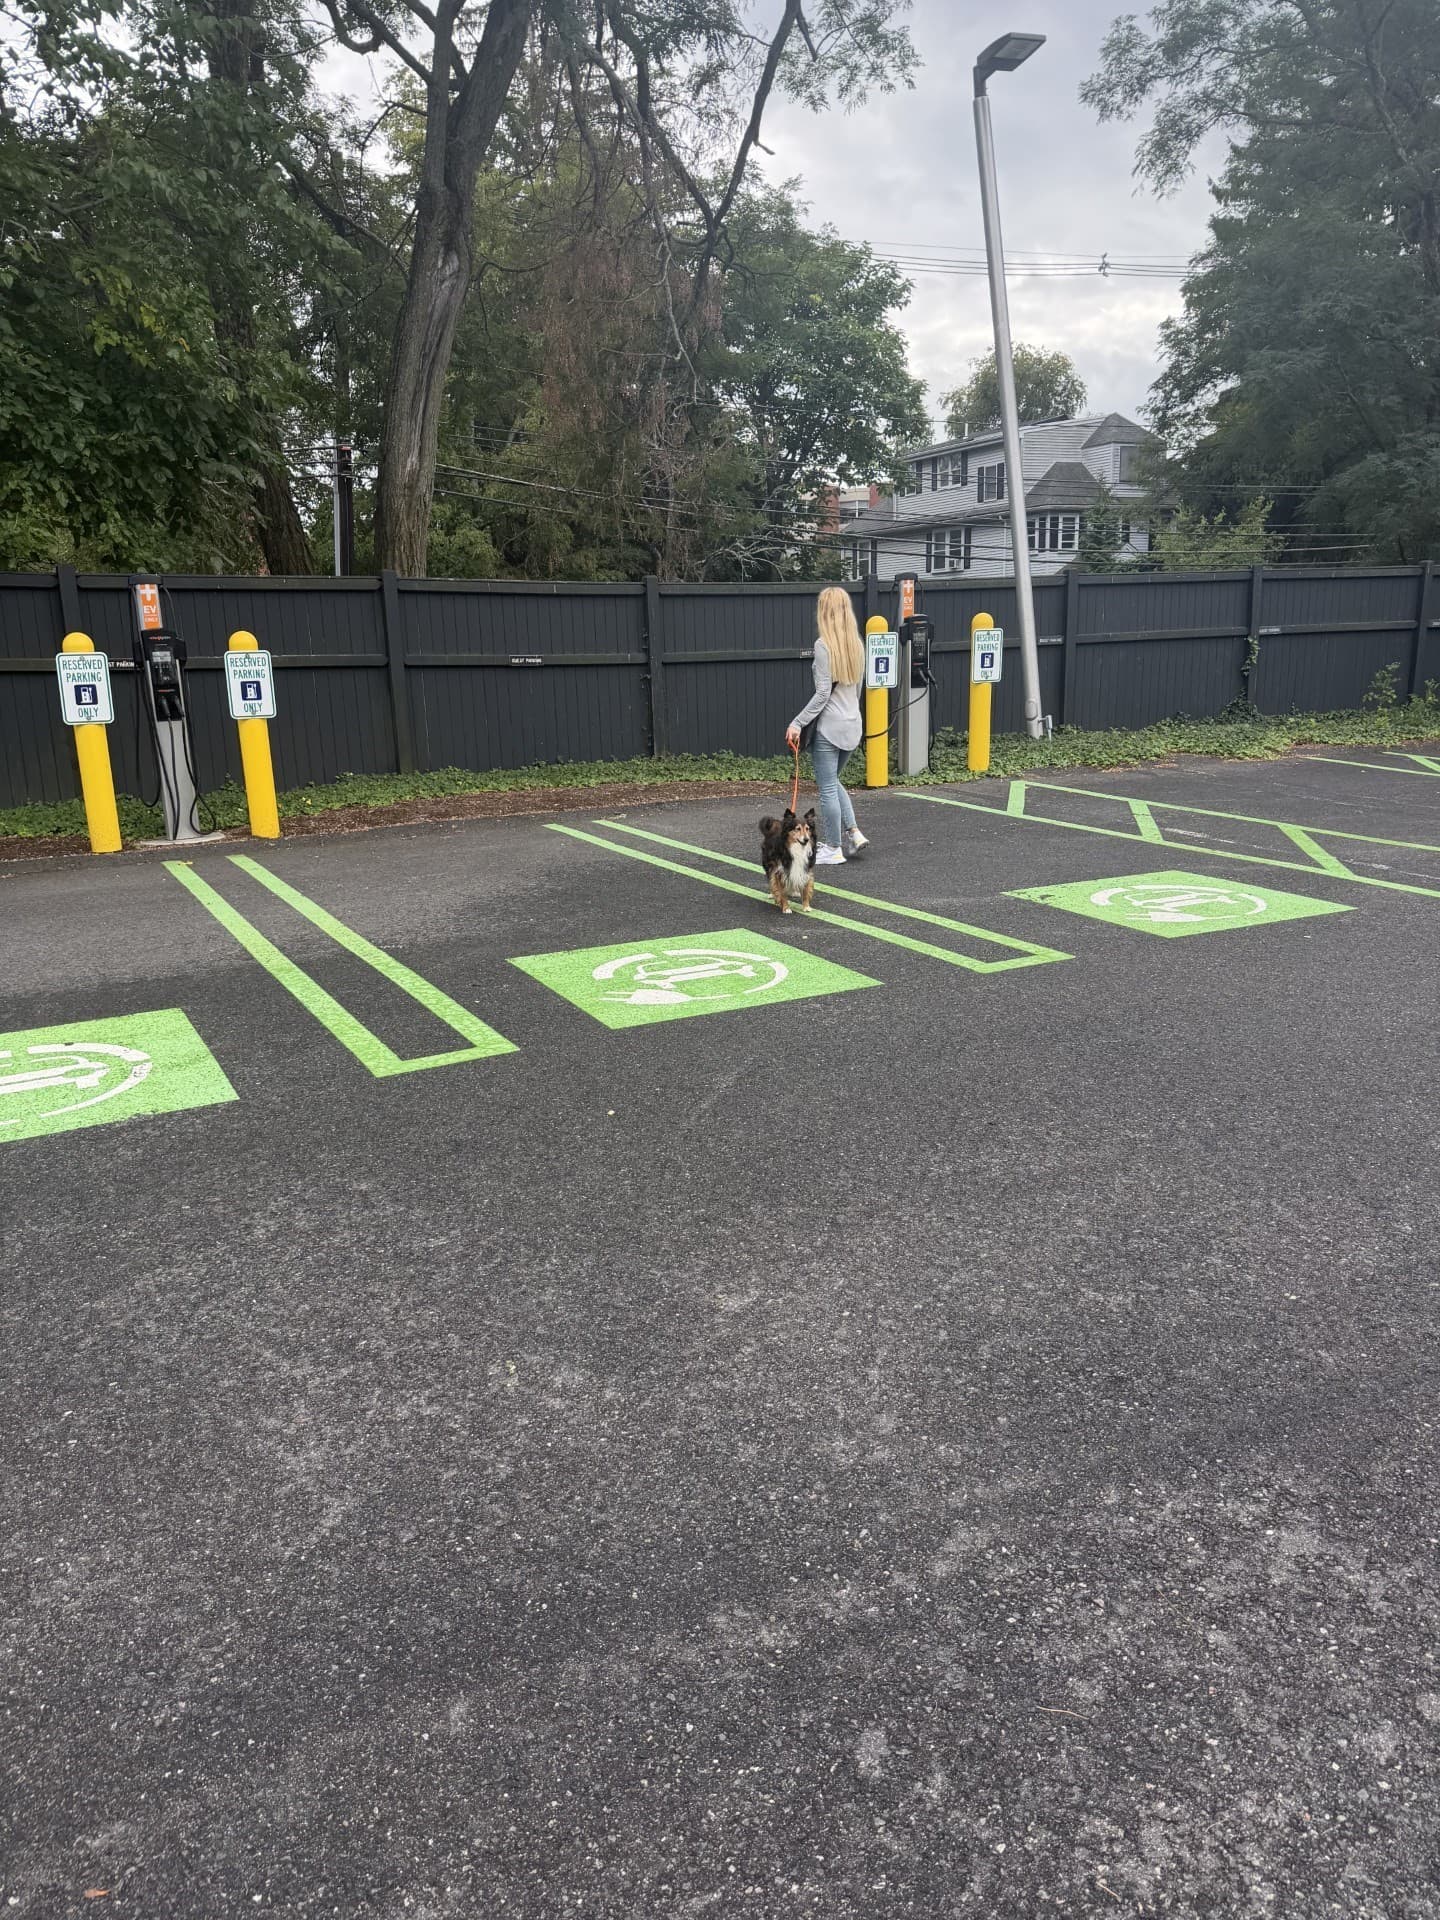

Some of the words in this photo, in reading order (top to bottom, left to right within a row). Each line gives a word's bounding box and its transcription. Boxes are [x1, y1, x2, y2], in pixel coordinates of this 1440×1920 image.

[143, 605, 157, 613] EV
[871, 637, 895, 646] RESERVED
[976, 633, 1000, 642] RESERVED
[871, 647, 893, 656] PARKING
[977, 643, 999, 651] PARKING
[62, 659, 103, 670] RESERVED
[230, 656, 267, 667] RESERVED
[66, 672, 102, 682] PARKING
[233, 668, 266, 679] PARKING
[78, 707, 98, 718] ONLY
[244, 702, 263, 713] ONLY
